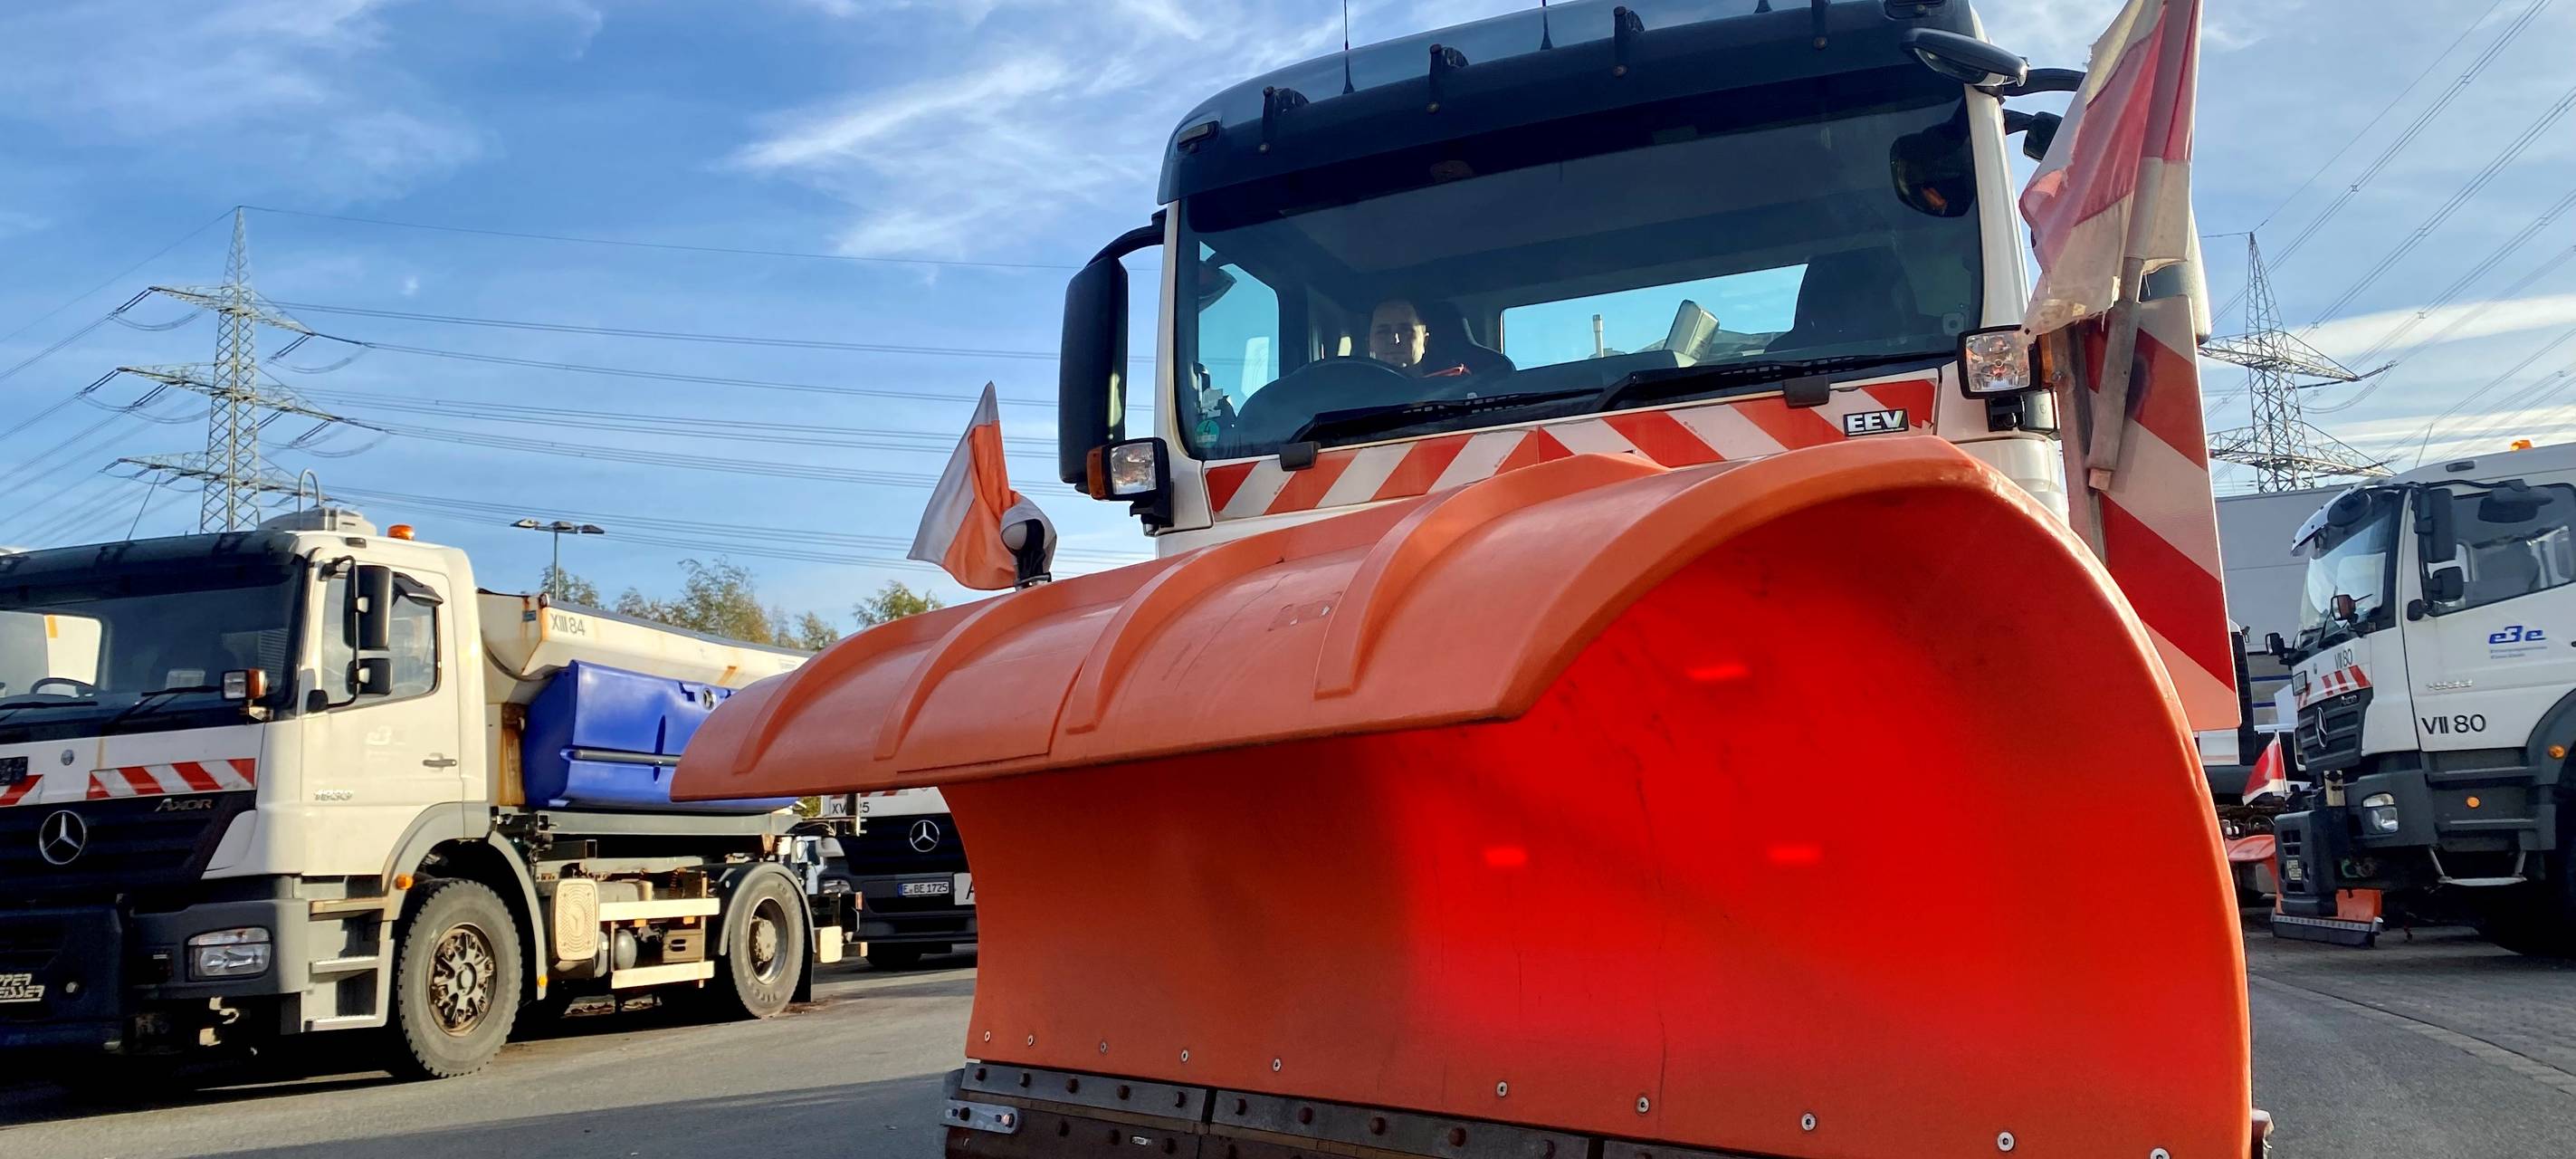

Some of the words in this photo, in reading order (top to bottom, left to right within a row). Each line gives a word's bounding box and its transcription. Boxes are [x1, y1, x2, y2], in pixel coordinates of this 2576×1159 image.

[1846, 410, 1904, 433] EEV
[568, 617, 586, 636] 84
[2342, 648, 2353, 666] 80
[2421, 715, 2449, 735] VII
[2454, 714, 2486, 733] 80
[927, 883, 949, 893] 1725
